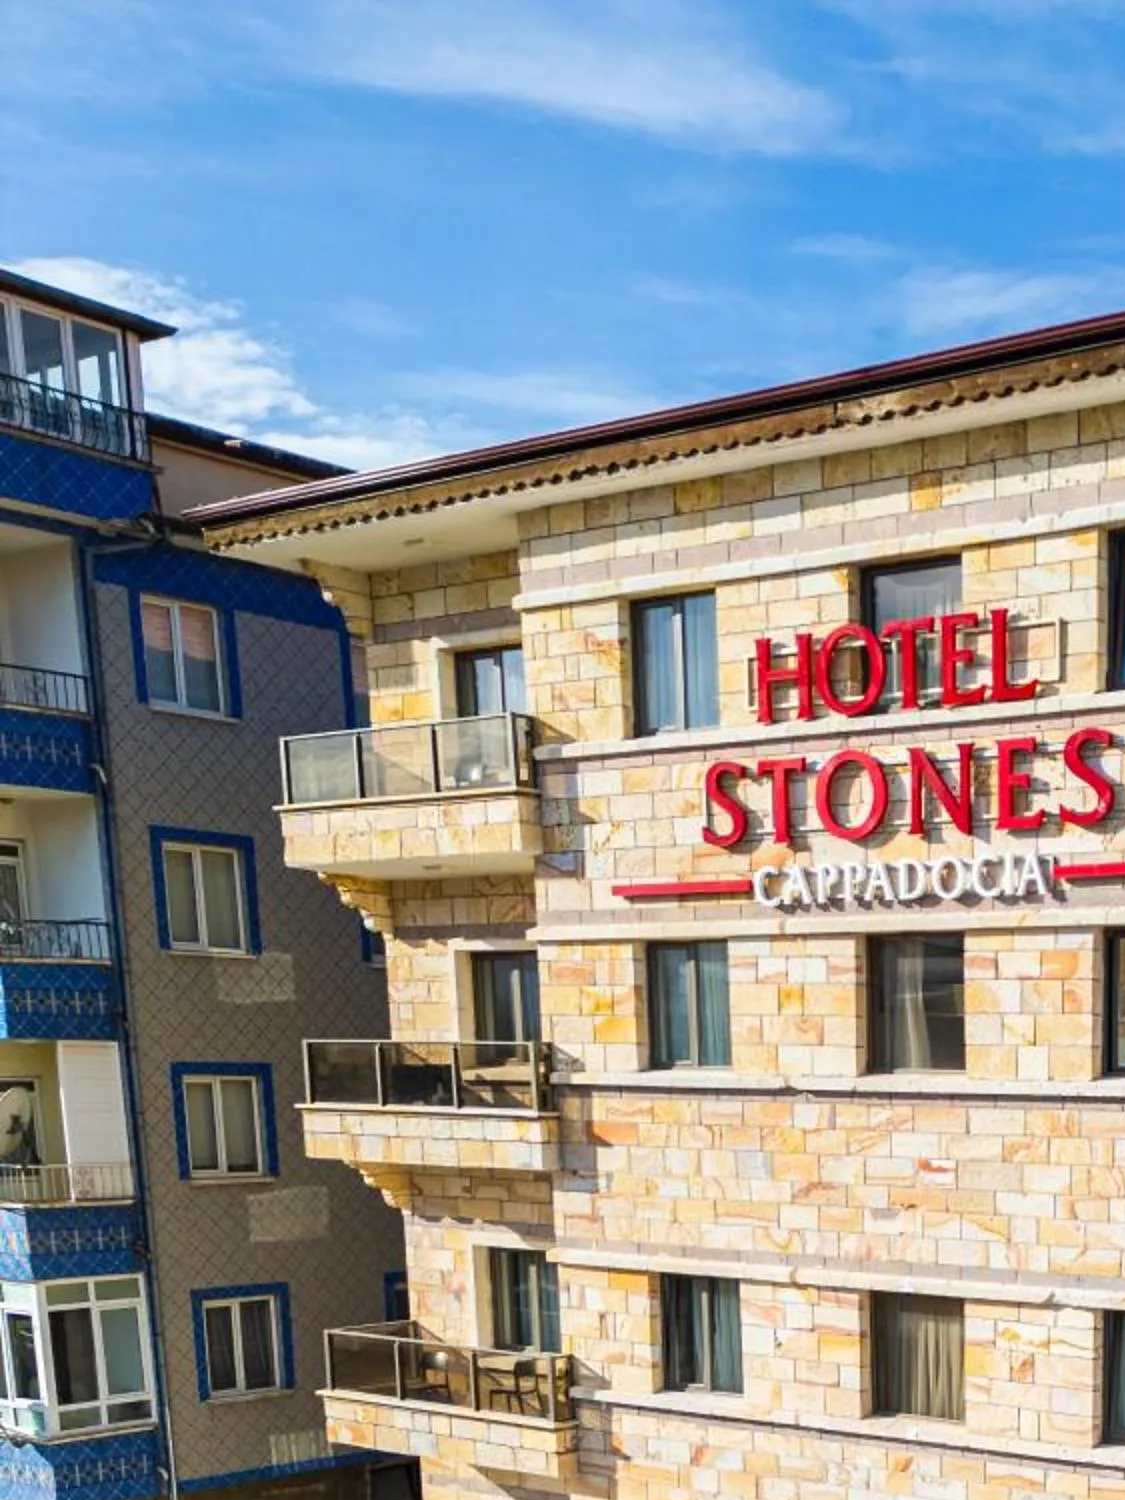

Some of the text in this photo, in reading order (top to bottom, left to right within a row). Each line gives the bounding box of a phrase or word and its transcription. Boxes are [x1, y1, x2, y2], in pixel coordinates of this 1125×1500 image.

[755, 608, 1038, 725] HOTEL
[702, 726, 1114, 848] STONES
[751, 854, 1050, 908] CAPPADOCIA
